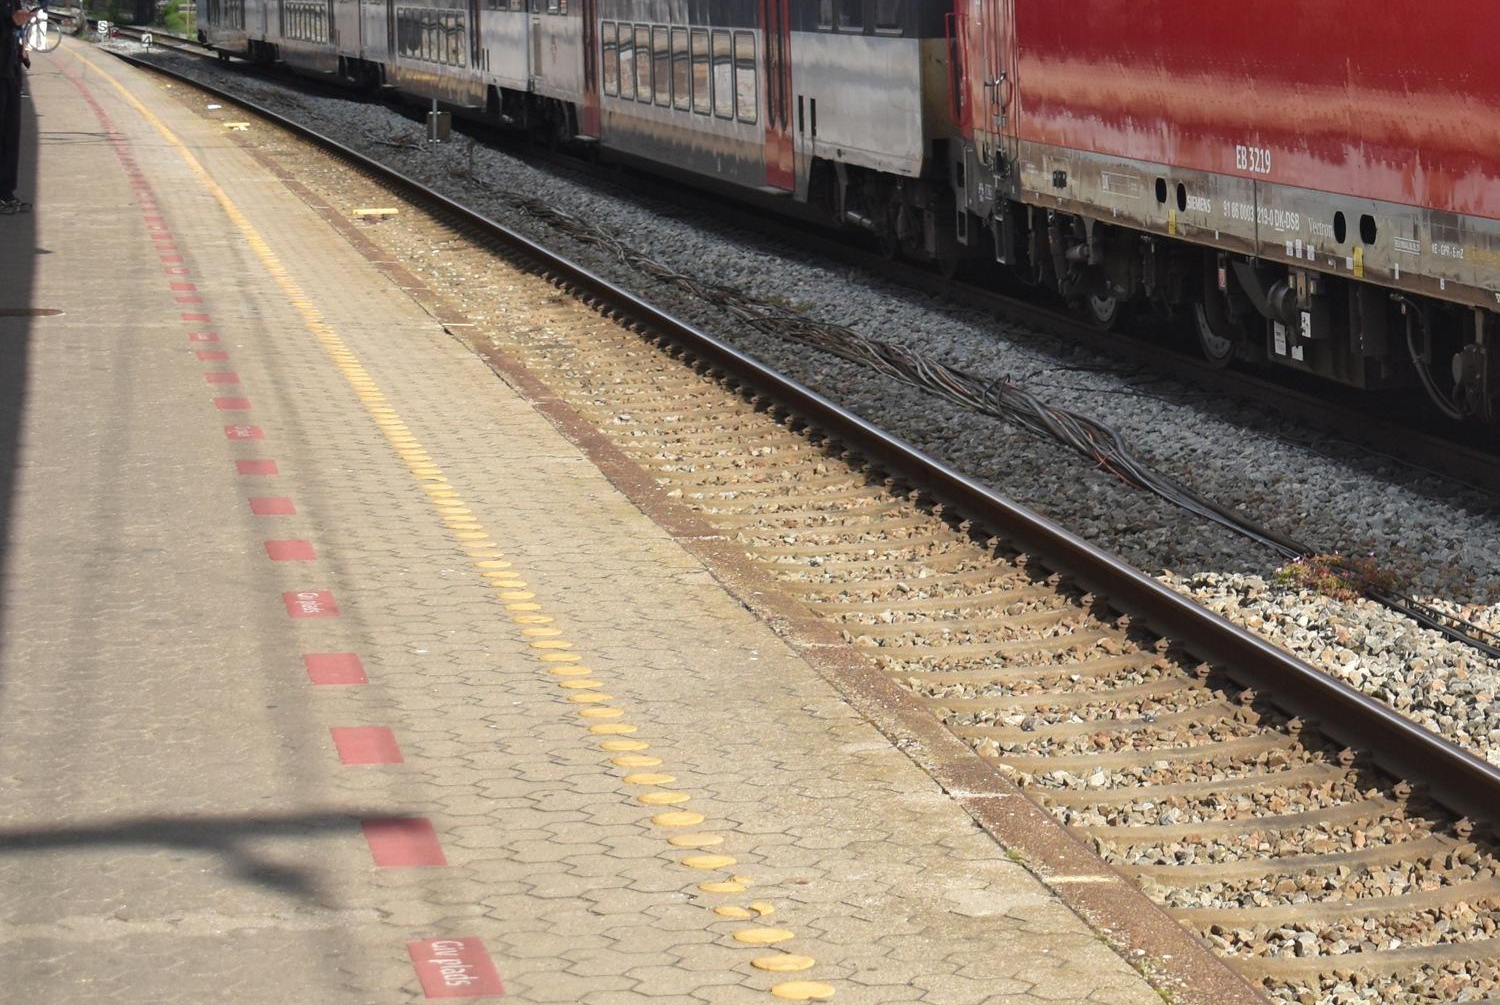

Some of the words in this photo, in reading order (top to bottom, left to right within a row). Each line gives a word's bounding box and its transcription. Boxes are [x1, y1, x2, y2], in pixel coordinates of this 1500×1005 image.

[143, 35, 152, 47] 4
[1236, 145, 1248, 170] EB
[1248, 146, 1271, 174] 3219
[1186, 194, 1212, 214] SIEMENS
[1308, 216, 1334, 237] Vectron
[428, 958, 480, 987] plads
